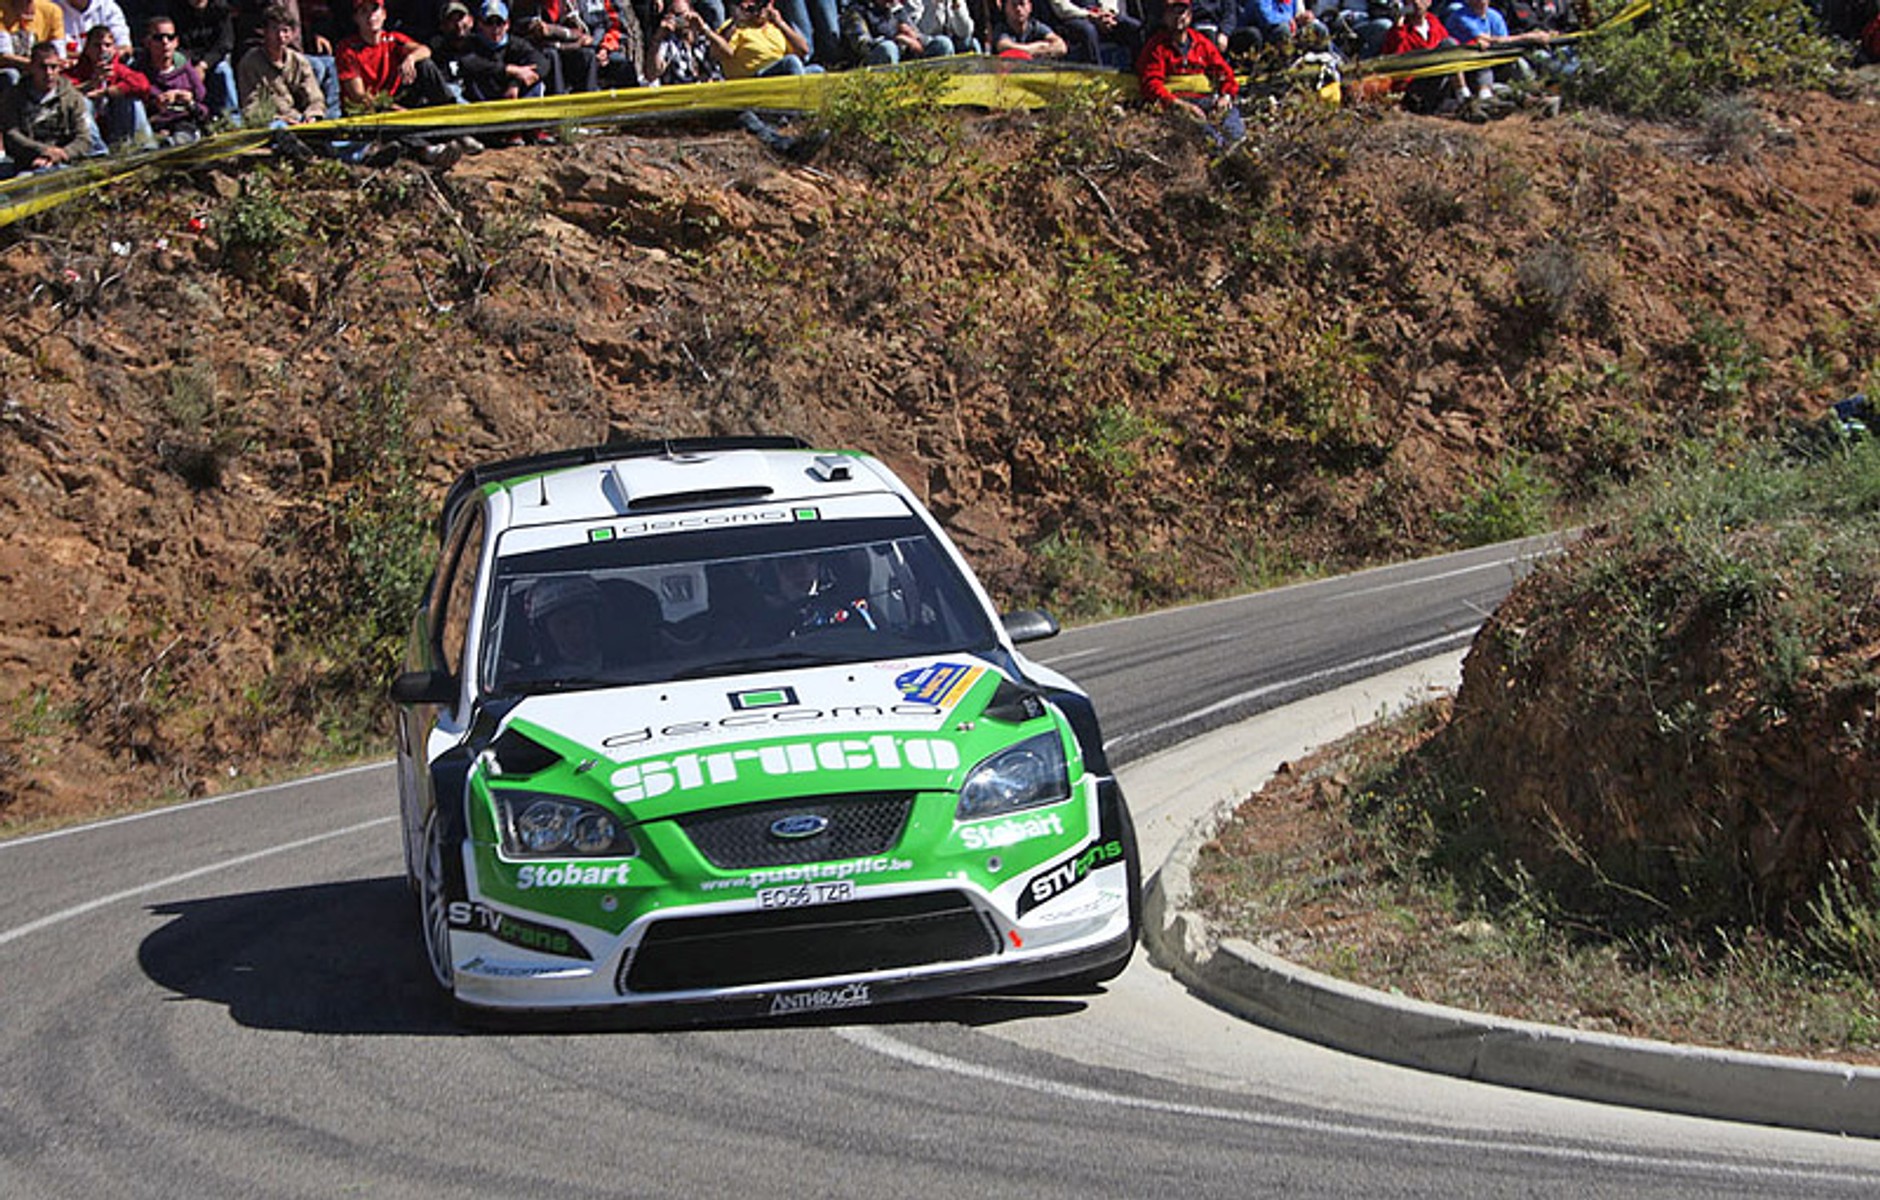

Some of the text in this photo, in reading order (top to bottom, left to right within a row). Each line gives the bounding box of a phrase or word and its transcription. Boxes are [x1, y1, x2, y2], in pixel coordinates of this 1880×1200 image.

[610, 735, 960, 804] structo
[960, 812, 1064, 849] Stobart
[516, 862, 631, 890] Stobart
[816, 883, 852, 902] TZR
